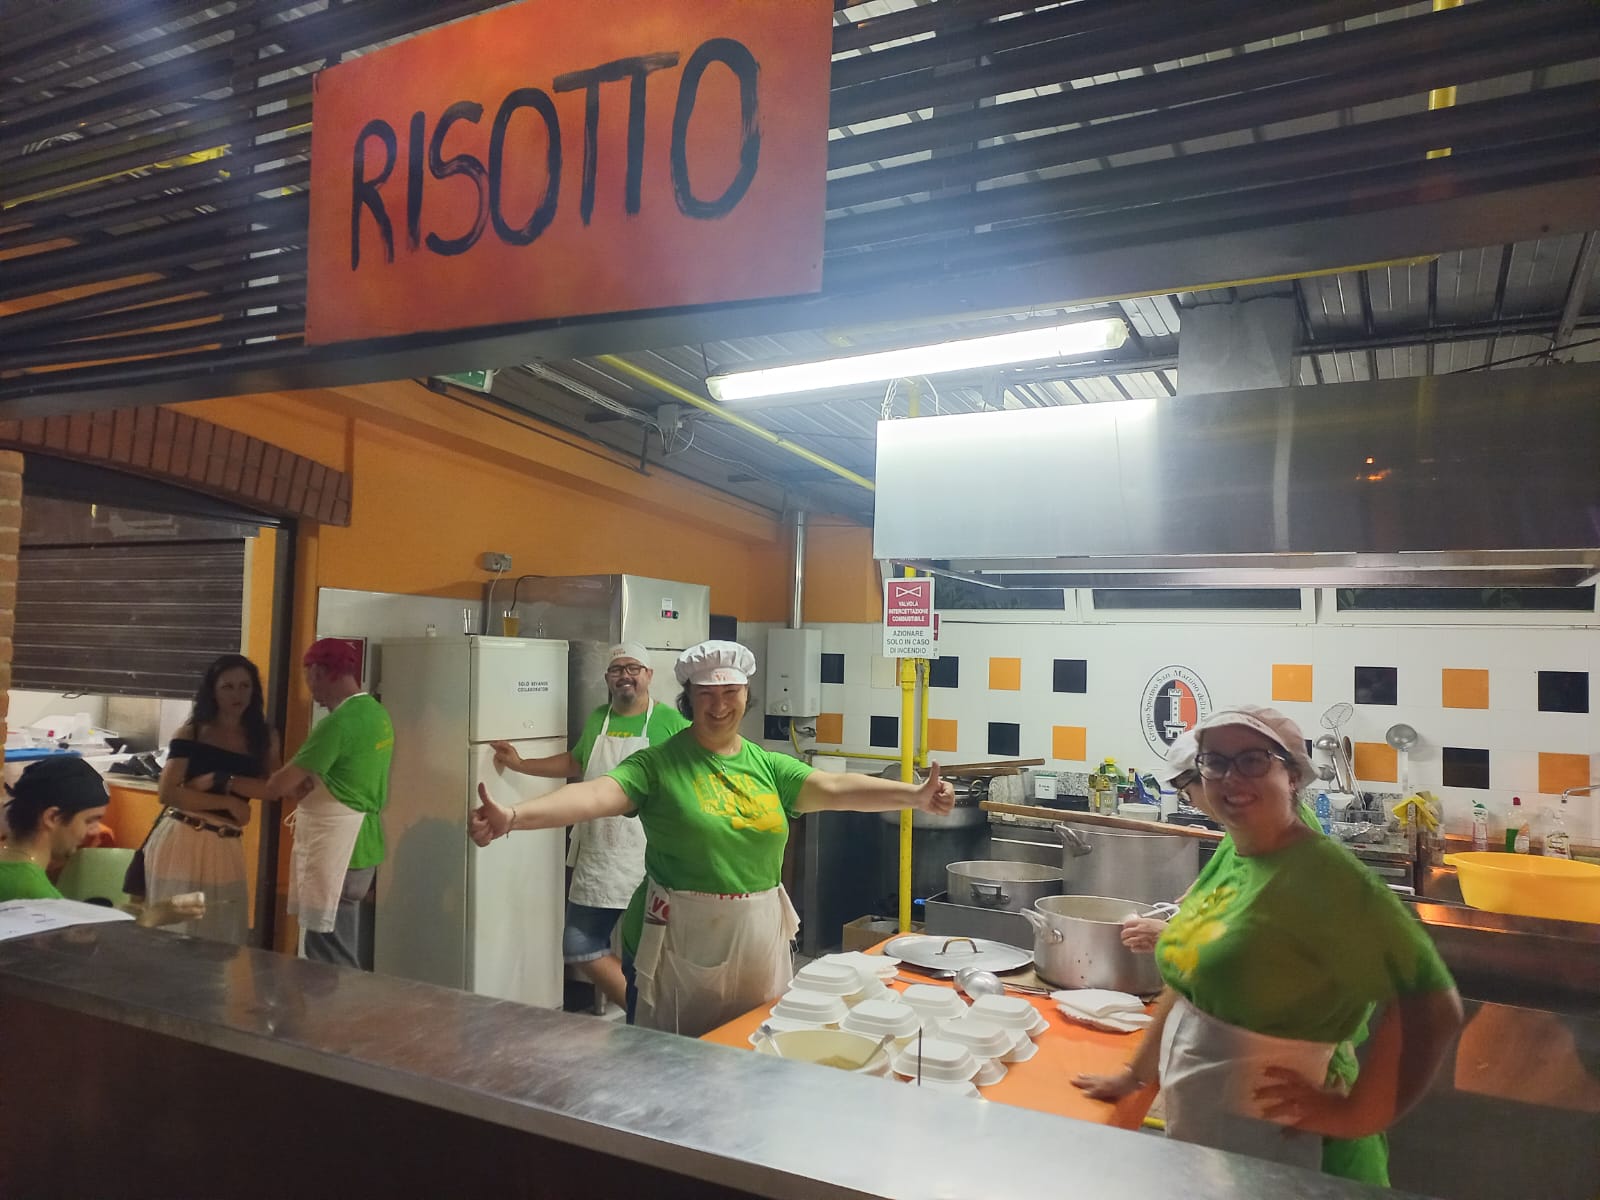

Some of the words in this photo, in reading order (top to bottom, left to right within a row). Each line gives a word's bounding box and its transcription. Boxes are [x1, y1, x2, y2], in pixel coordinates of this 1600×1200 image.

[351, 37, 762, 272] RISOTTO
[1146, 714, 1157, 742] Gruppo
[1156, 672, 1171, 684] San
[1173, 669, 1200, 692] Martino
